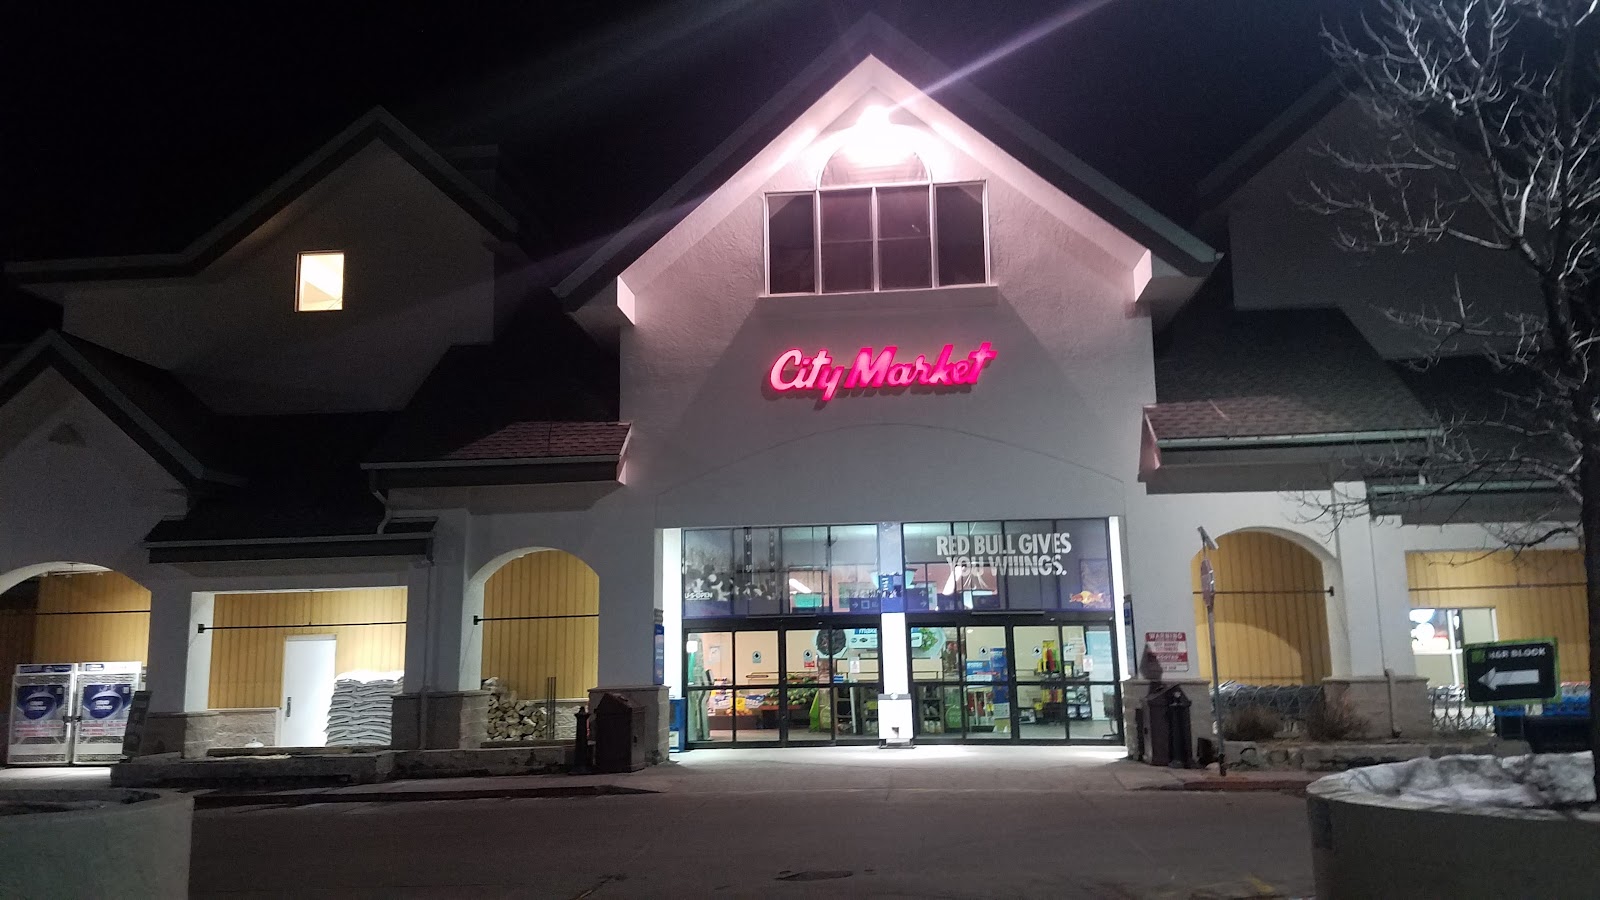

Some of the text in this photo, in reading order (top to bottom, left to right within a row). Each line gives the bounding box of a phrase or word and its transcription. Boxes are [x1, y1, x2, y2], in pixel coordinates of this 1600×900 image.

[770, 342, 998, 401] City Market
[936, 532, 1072, 556] RED BULL GIVES
[946, 554, 1067, 577] YOU WIIINGS.
[1510, 647, 1546, 658] BLOCK
